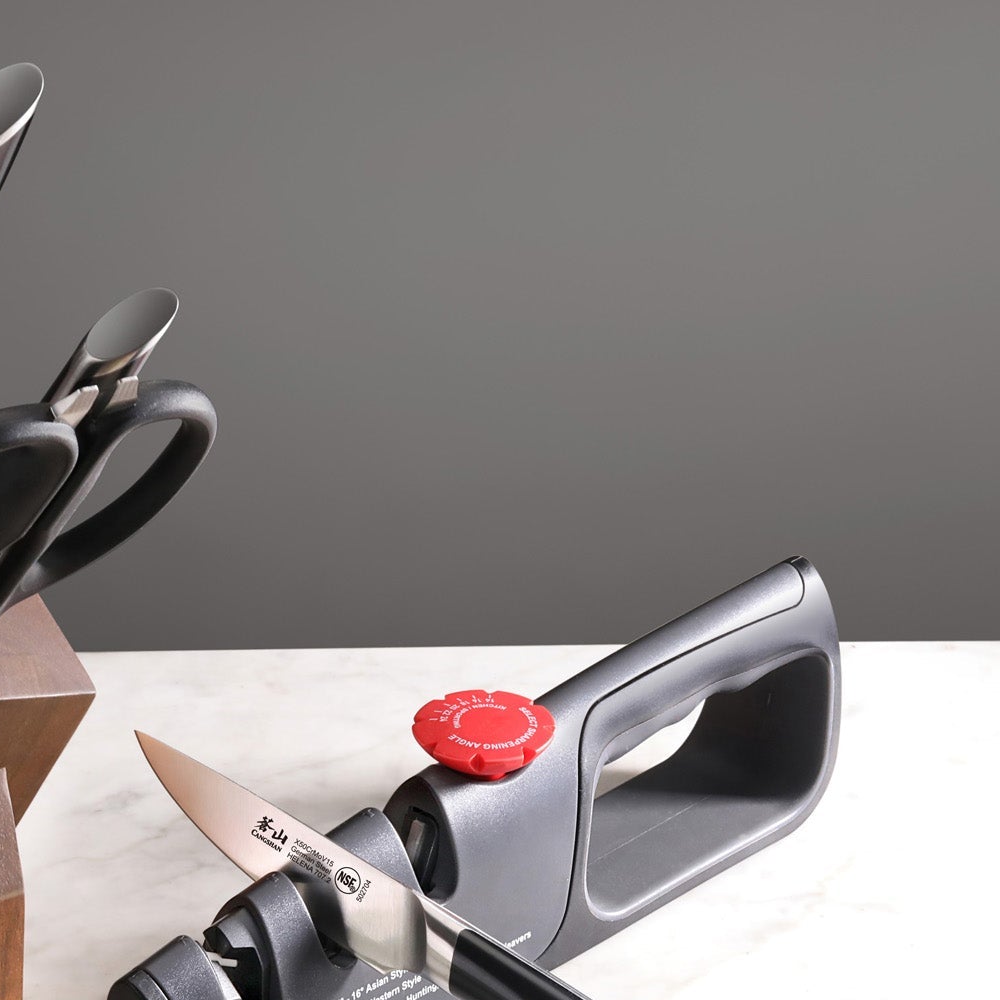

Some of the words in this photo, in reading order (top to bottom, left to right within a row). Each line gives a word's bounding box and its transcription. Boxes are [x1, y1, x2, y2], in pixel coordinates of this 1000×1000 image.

[518, 706, 538, 729] SELECT
[448, 734, 481, 748] ANGLE
[482, 728, 537, 750] SHARPENING
[251, 829, 282, 852] CANGSHAN
[286, 852, 313, 874] HELENA
[290, 845, 316, 865] German
[315, 861, 332, 875] Steel
[293, 838, 334, 867] X50CrMoV15
[355, 879, 372, 903] 502704
[351, 986, 364, 1000] 16°
[365, 976, 389, 994] Asian
[401, 975, 422, 991] Style
